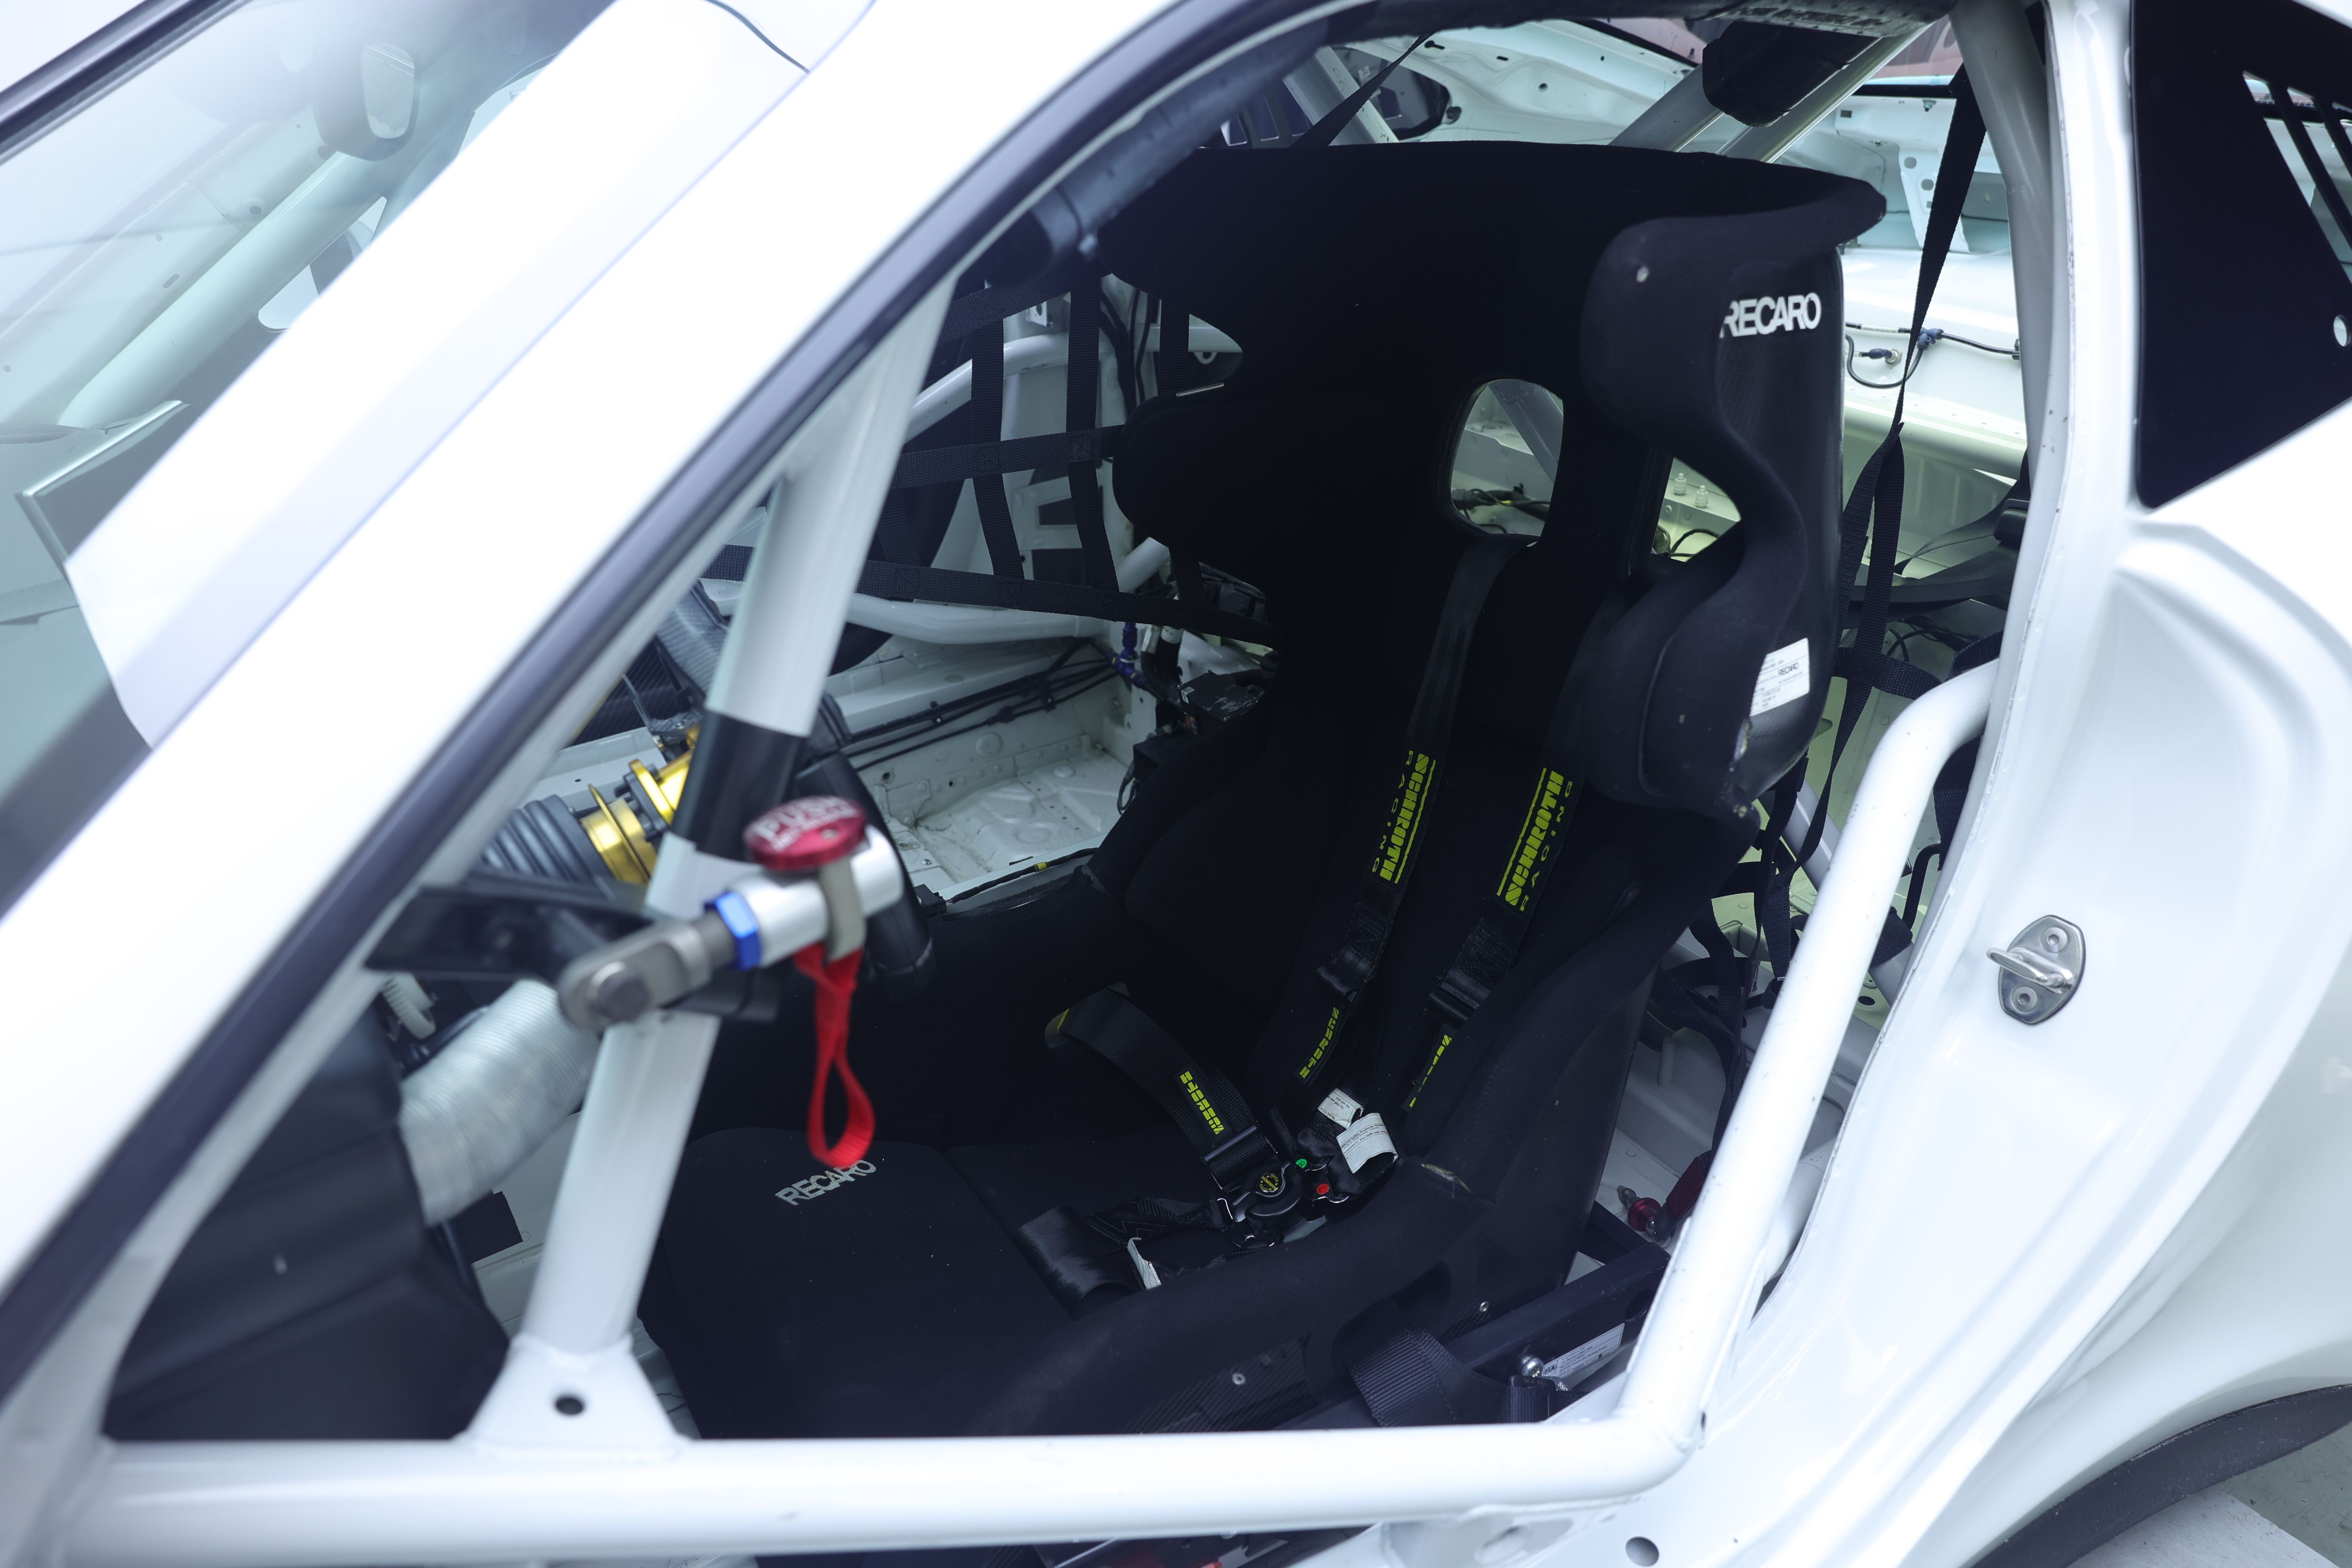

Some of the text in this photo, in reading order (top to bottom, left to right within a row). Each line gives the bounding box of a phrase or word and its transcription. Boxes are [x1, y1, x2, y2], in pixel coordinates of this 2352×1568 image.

[1719, 292, 1822, 339] RECARO
[1778, 662, 1798, 677] RECARO
[1379, 753, 1429, 881] SCHROTH
[1505, 771, 1564, 906] SCHROTH
[1360, 1125, 1374, 1133] Products
[774, 1160, 876, 1206] RECARO
